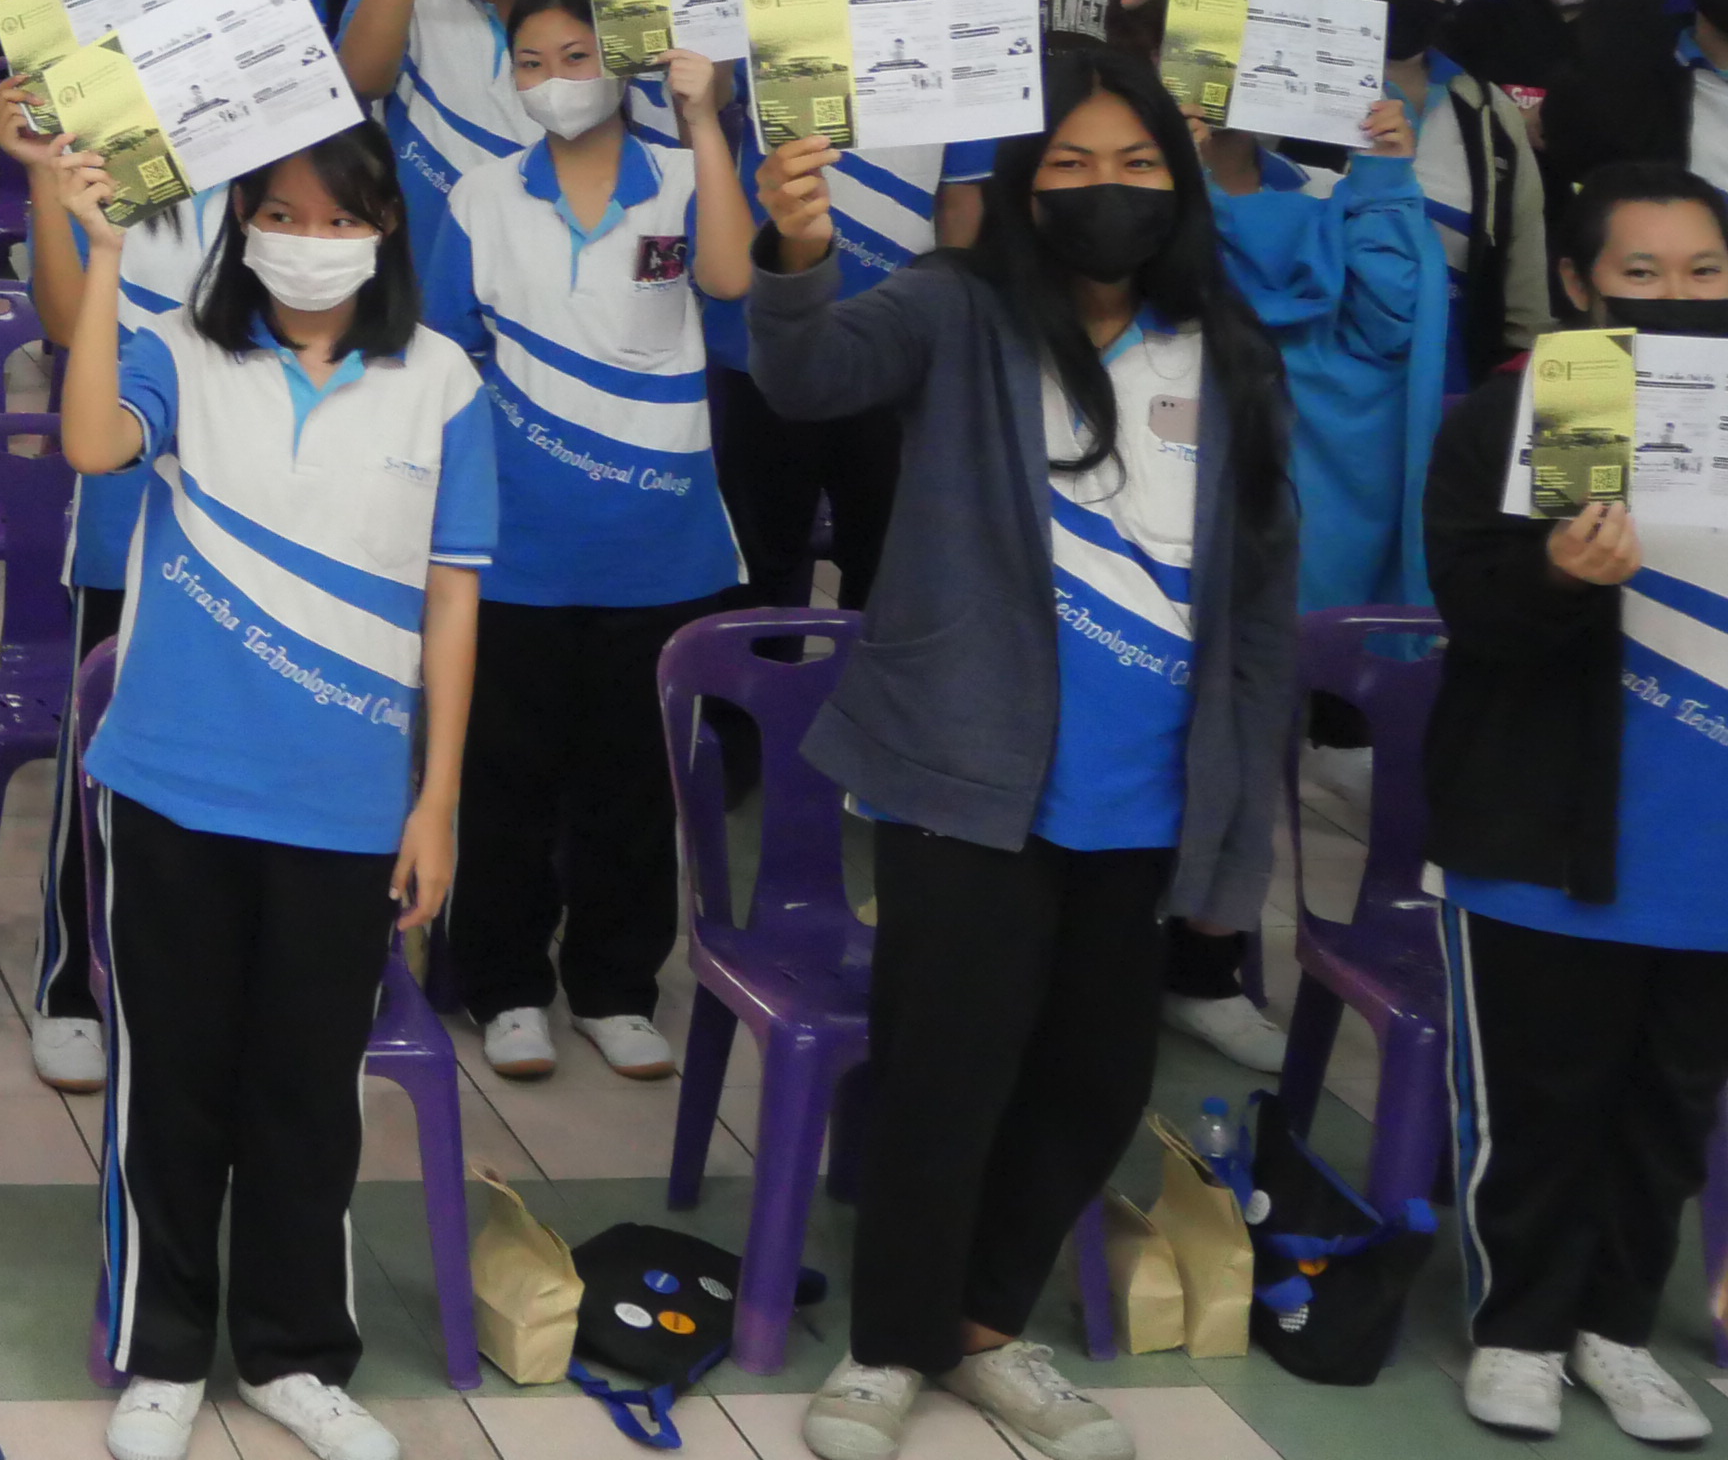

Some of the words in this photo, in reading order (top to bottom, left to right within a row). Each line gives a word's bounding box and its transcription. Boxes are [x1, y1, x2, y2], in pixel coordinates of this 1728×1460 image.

[526, 422, 635, 484] Technological
[161, 554, 241, 631] Sriracha
[241, 625, 373, 716] Technological
[1621, 671, 1672, 708] acha
